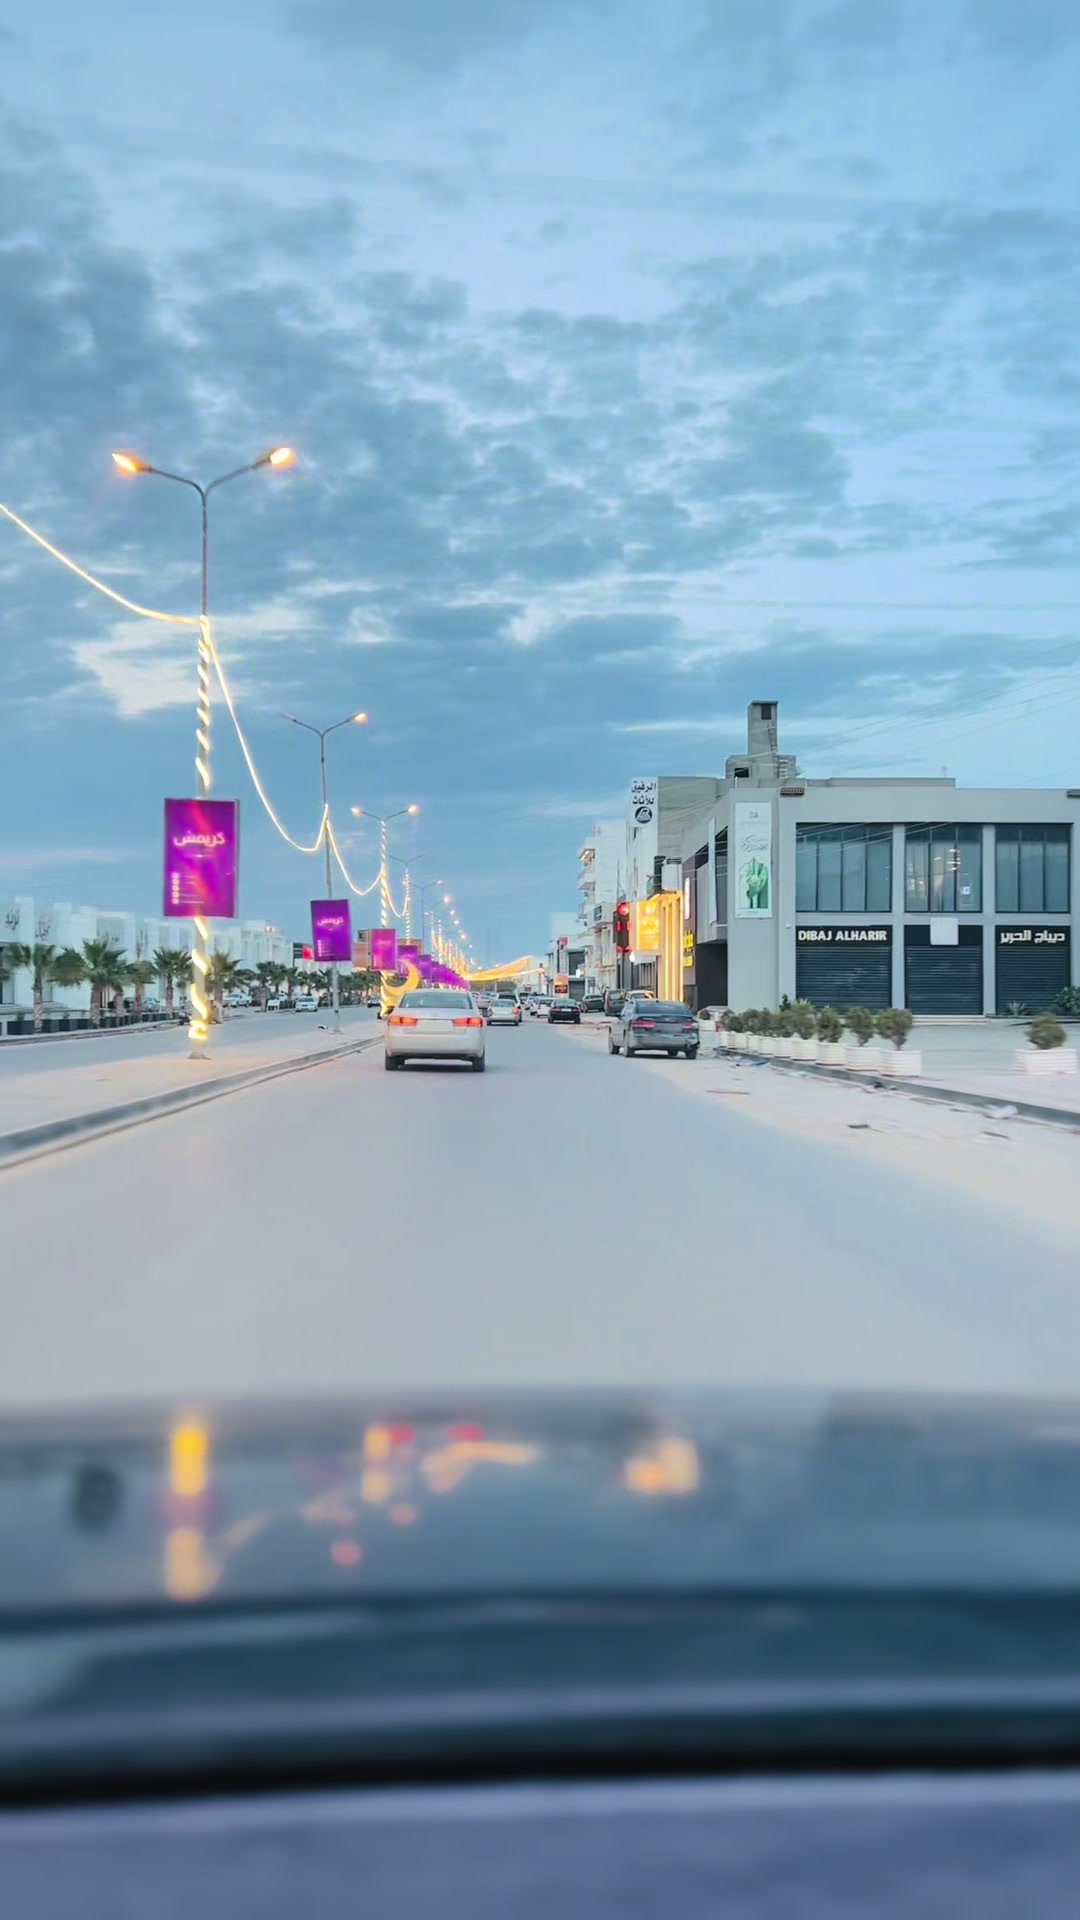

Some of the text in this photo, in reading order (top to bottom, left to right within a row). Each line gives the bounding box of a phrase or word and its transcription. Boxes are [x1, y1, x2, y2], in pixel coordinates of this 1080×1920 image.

[631, 781, 656, 793] الرفيق
[798, 930, 887, 941] DIBAJ ALHARIR
[1000, 930, 1065, 944] ديباج الحرير
